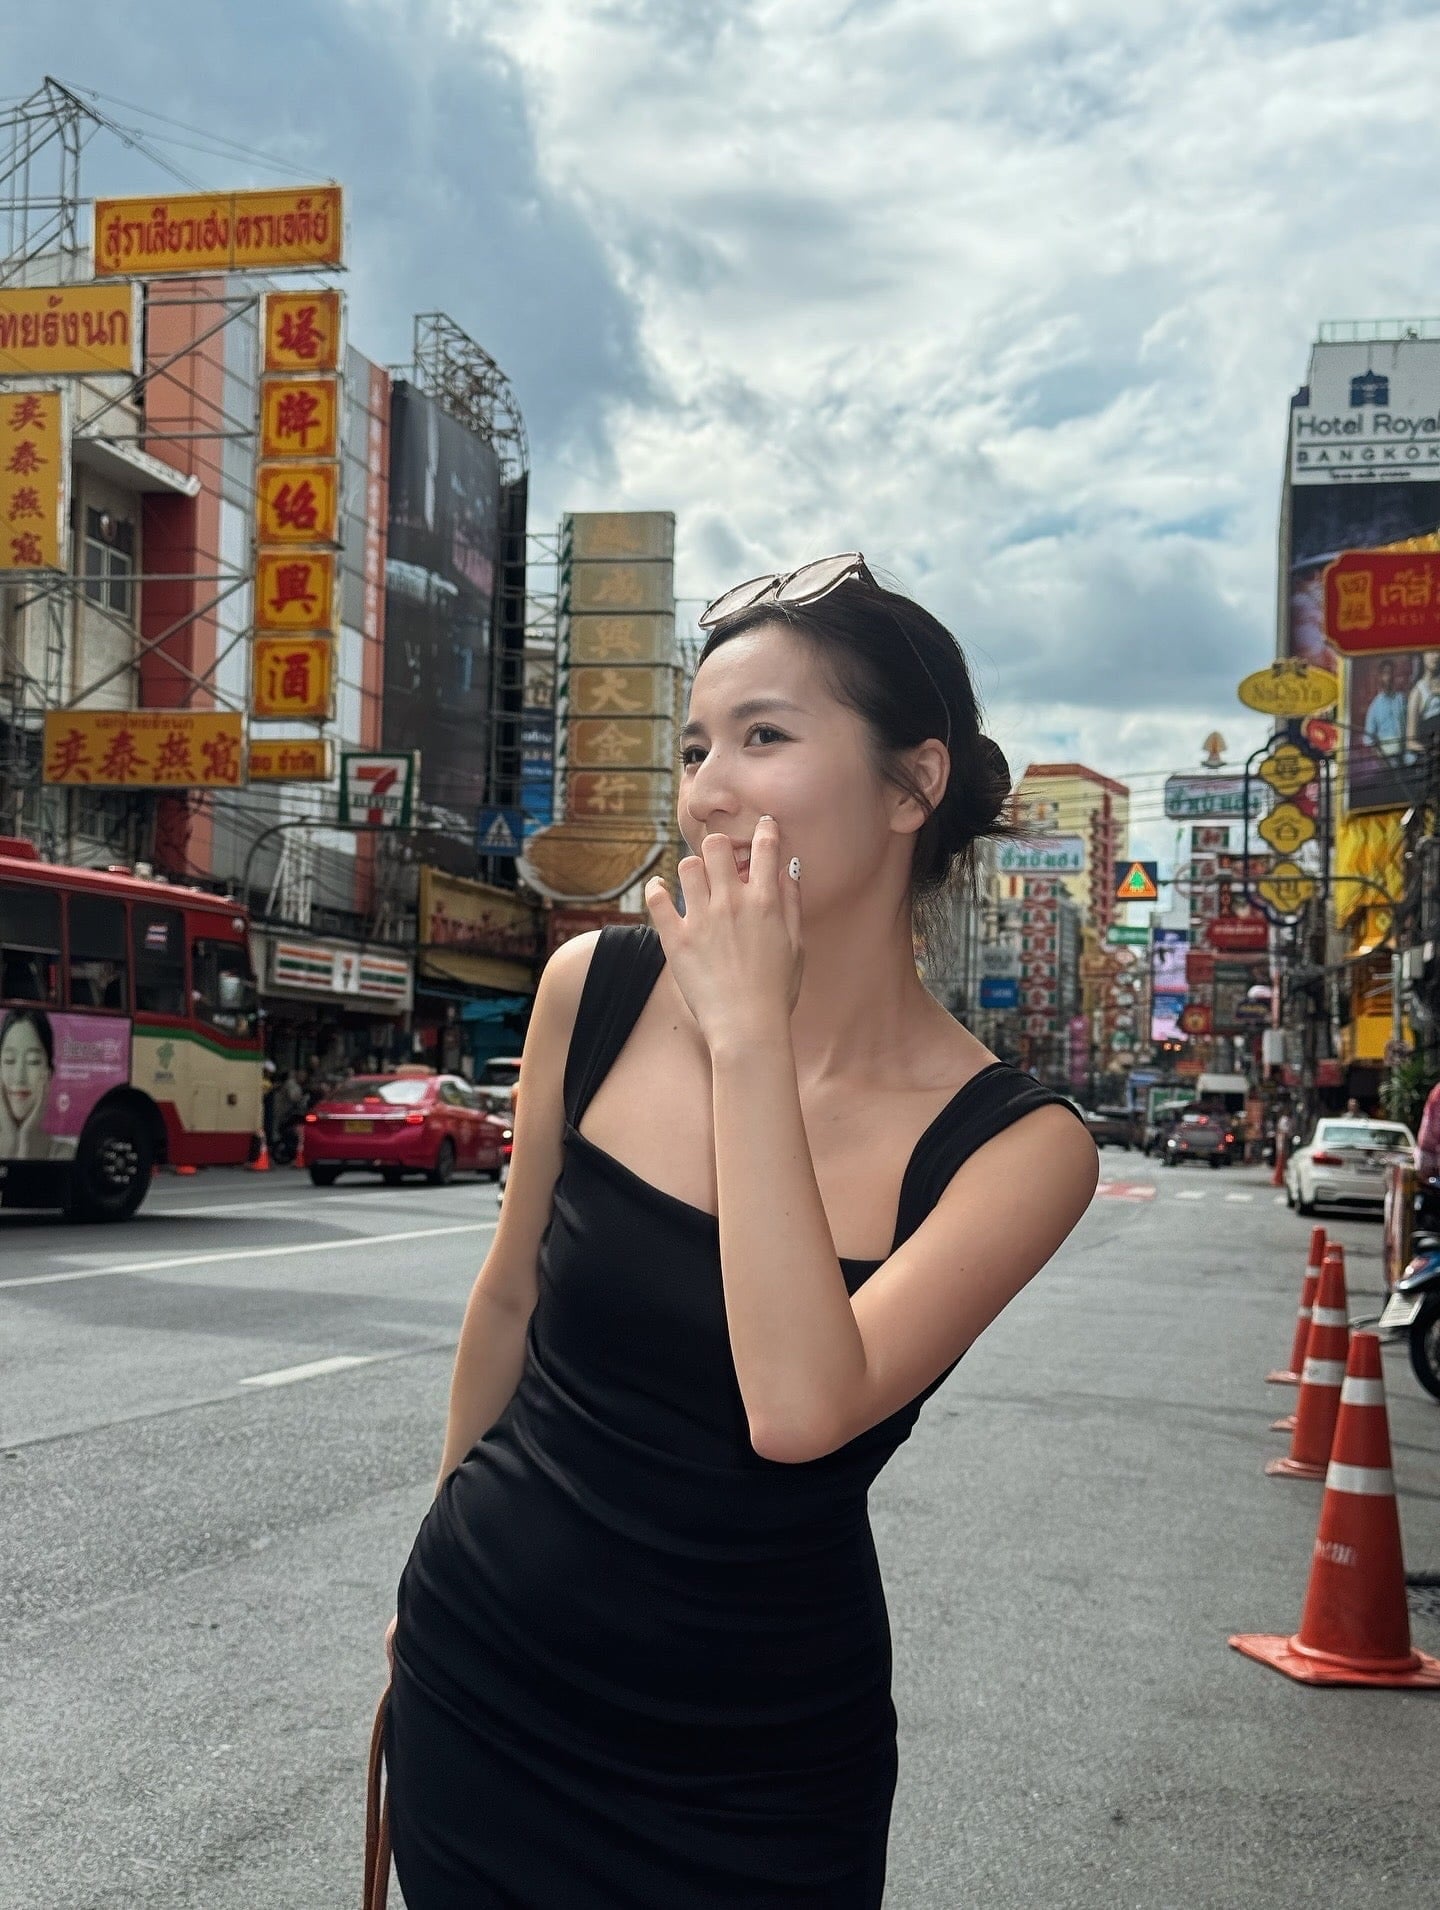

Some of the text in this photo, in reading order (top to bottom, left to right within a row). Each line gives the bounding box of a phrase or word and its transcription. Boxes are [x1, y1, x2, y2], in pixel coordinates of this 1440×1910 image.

[1296, 413, 1365, 438] Hotel
[1296, 445, 1440, 464] BANGKOK
[268, 305, 327, 704] 塔牌紹興酒
